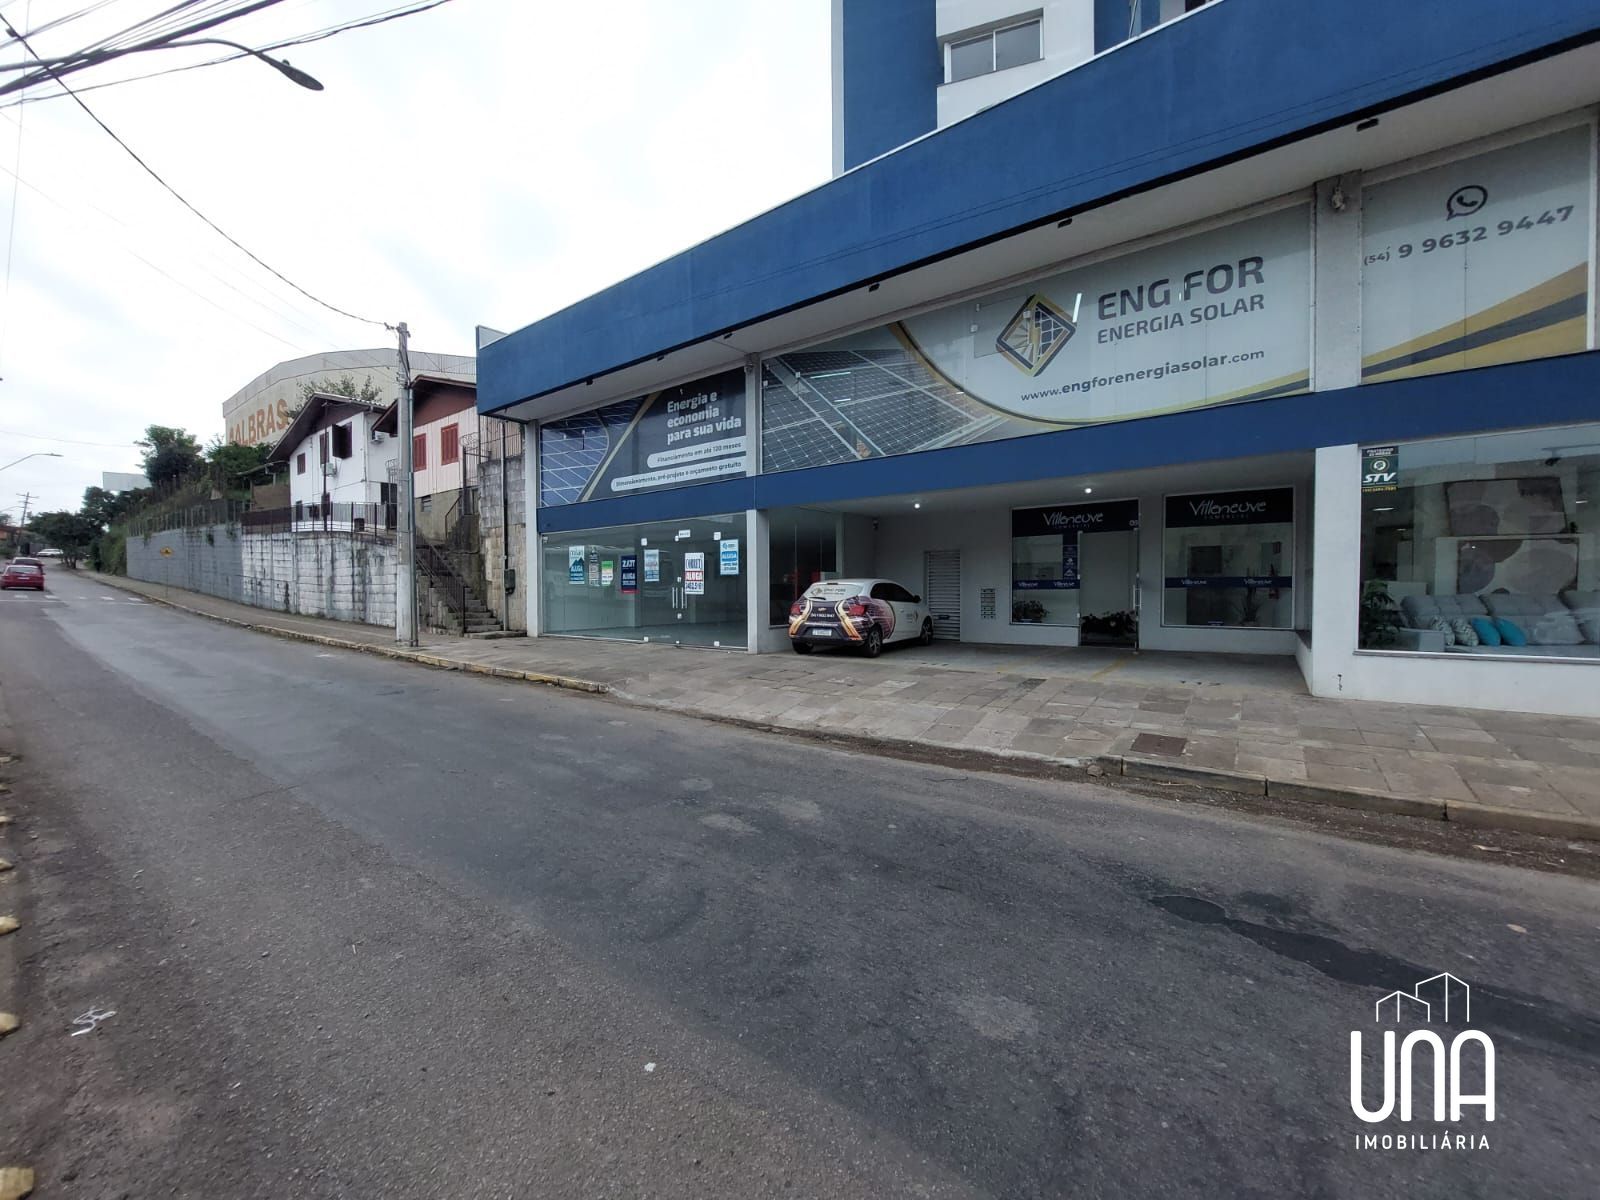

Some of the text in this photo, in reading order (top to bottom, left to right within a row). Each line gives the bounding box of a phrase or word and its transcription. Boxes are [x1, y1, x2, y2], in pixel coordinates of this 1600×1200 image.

[1364, 205, 1575, 267] (54) 9 9632 9447
[1097, 256, 1265, 321] ENG FOR
[1097, 293, 1265, 345] ENERGIA SOLAR
[1020, 349, 1265, 402] www.engforenergiasolar.com
[667, 391, 718, 413] Energia e
[667, 405, 720, 428] economia
[667, 415, 742, 445] para sua vida
[1363, 472, 1396, 483] STV
[685, 571, 703, 581] ALUGA
